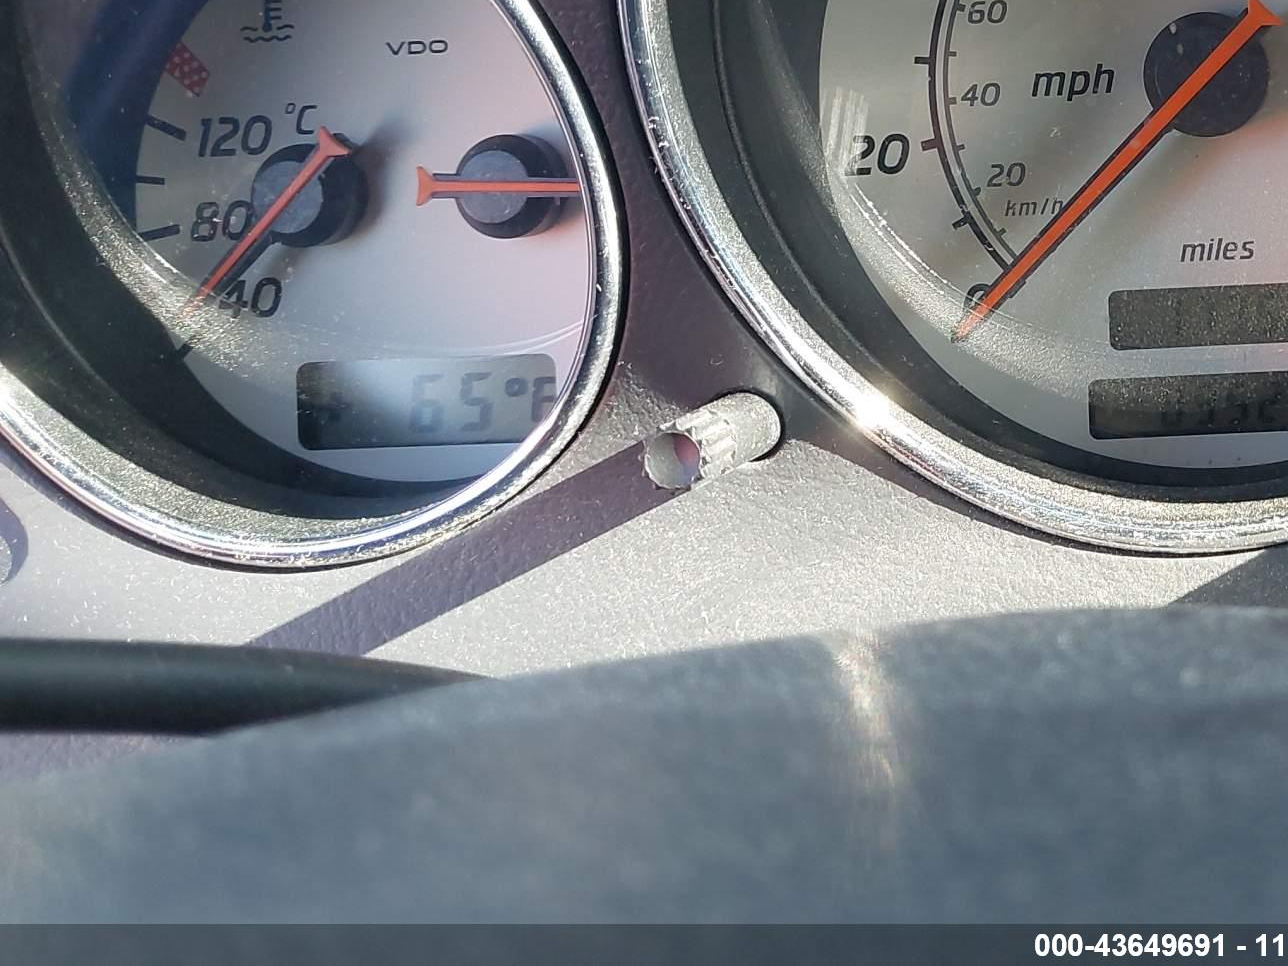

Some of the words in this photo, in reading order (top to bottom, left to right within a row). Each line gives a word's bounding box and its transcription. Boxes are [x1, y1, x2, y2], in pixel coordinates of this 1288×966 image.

[967, 0, 1008, 25] 60
[386, 39, 449, 56] VDO
[961, 82, 1001, 107] 40
[1031, 63, 1115, 102] mph
[197, 115, 273, 158] 120
[844, 133, 911, 177] 20
[986, 162, 1027, 188] 20
[190, 199, 255, 243] 80
[1004, 197, 1065, 217] km/h
[1180, 236, 1256, 264] miles
[218, 277, 283, 319] 40
